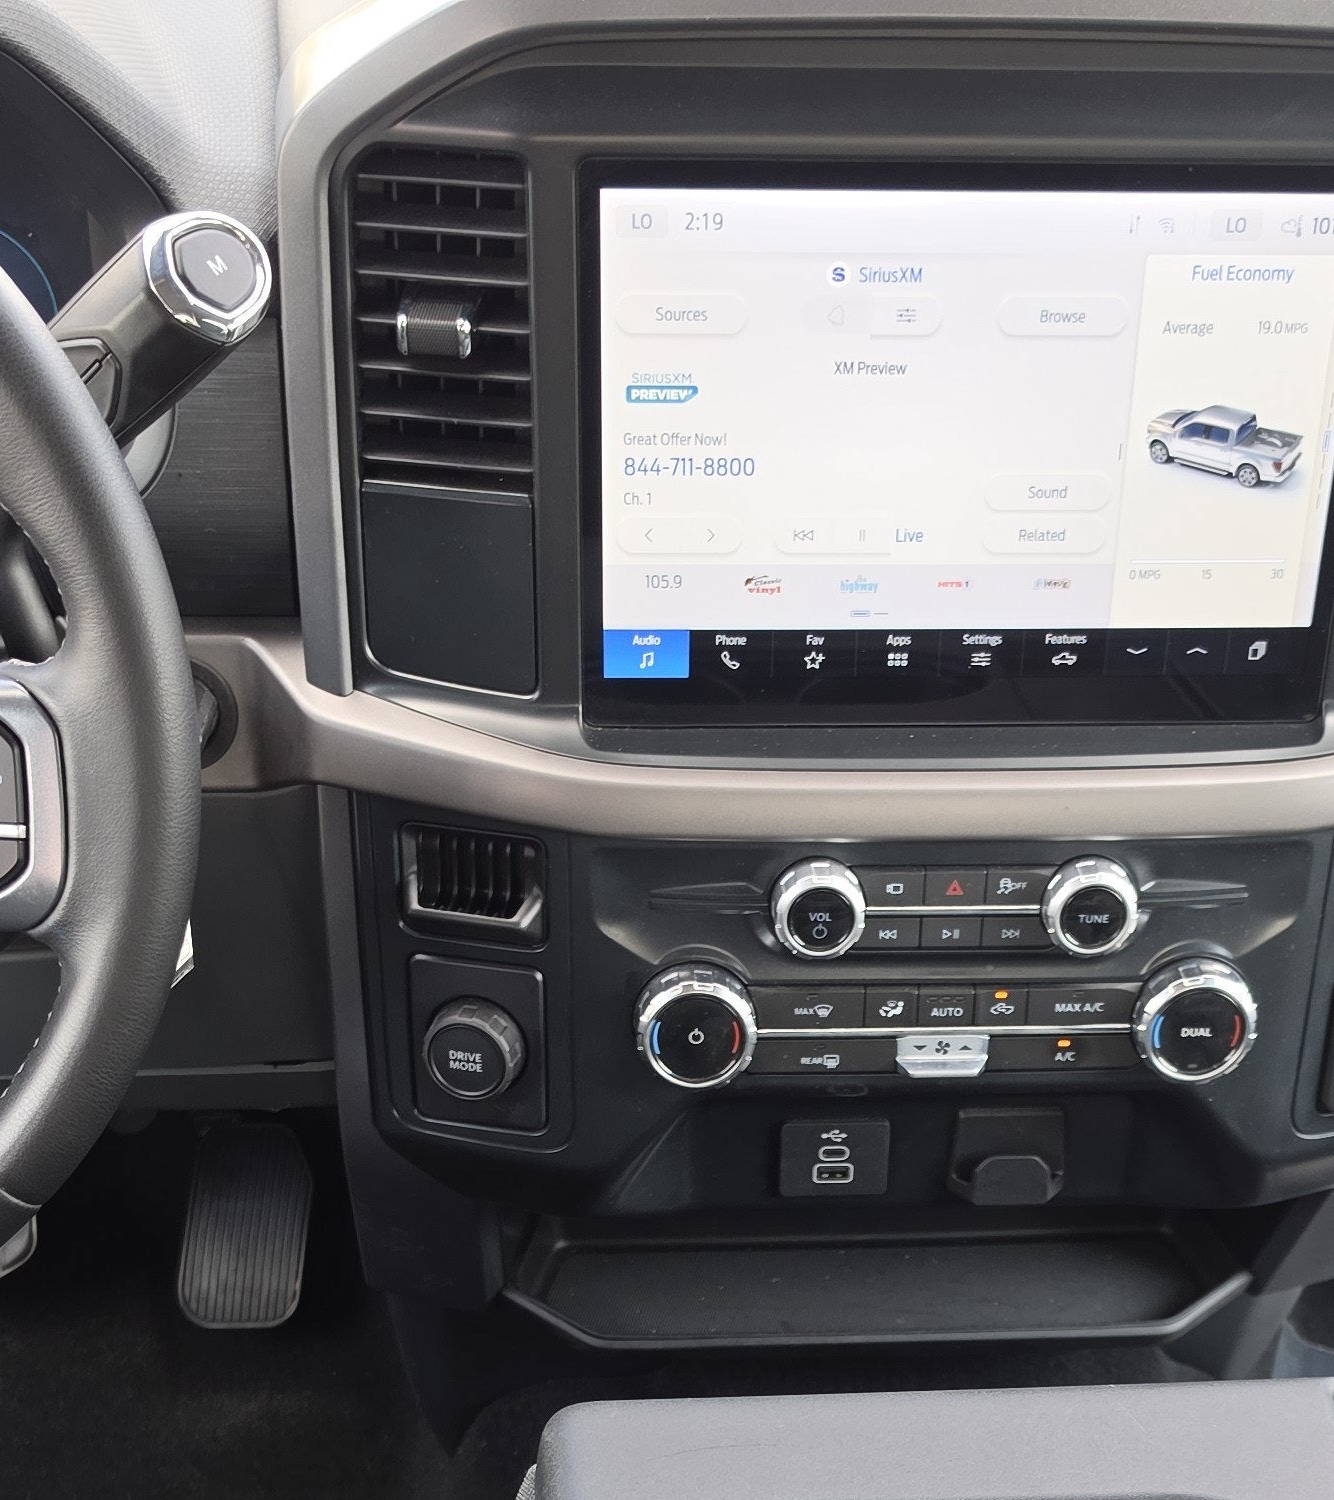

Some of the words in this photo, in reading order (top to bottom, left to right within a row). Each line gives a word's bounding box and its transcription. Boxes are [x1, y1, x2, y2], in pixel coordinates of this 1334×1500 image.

[630, 212, 653, 231] LO
[684, 212, 724, 231] 2:19
[1225, 216, 1247, 234] LO
[858, 266, 923, 284] SiriusXM
[1190, 265, 1223, 282] Fuel
[1226, 265, 1295, 285] Economy
[655, 305, 708, 323] Sources
[1039, 309, 1086, 325] Browse
[1162, 321, 1214, 337] Average
[1257, 320, 1283, 335] 19.0
[1284, 321, 1309, 335] MPG
[834, 361, 854, 376] XM
[857, 361, 908, 376] Preview
[623, 432, 658, 447] Great
[660, 432, 692, 447] Offer
[694, 432, 727, 447] Now!
[623, 457, 755, 477] 844-711-8800
[623, 491, 644, 506] Ch.
[1027, 485, 1068, 500] Sound
[895, 528, 924, 543] Live
[1018, 529, 1066, 543] Related
[644, 574, 683, 589] 105.9
[632, 634, 661, 646] Audio
[715, 634, 747, 646] Phone
[805, 634, 825, 646] Fav
[886, 634, 912, 647] Apps
[962, 633, 1003, 647] Settings
[1044, 633, 1087, 645] Features
[808, 912, 833, 923] VOL
[1078, 913, 1110, 925] TUNE
[930, 1007, 964, 1018] AUTO
[1054, 1003, 1082, 1013] MAX
[1083, 1002, 1105, 1013] A/C
[1180, 1027, 1213, 1038] DUAL
[448, 1050, 483, 1063] DRIVE
[1054, 1051, 1076, 1063] A/C
[449, 1060, 483, 1073] MODE
